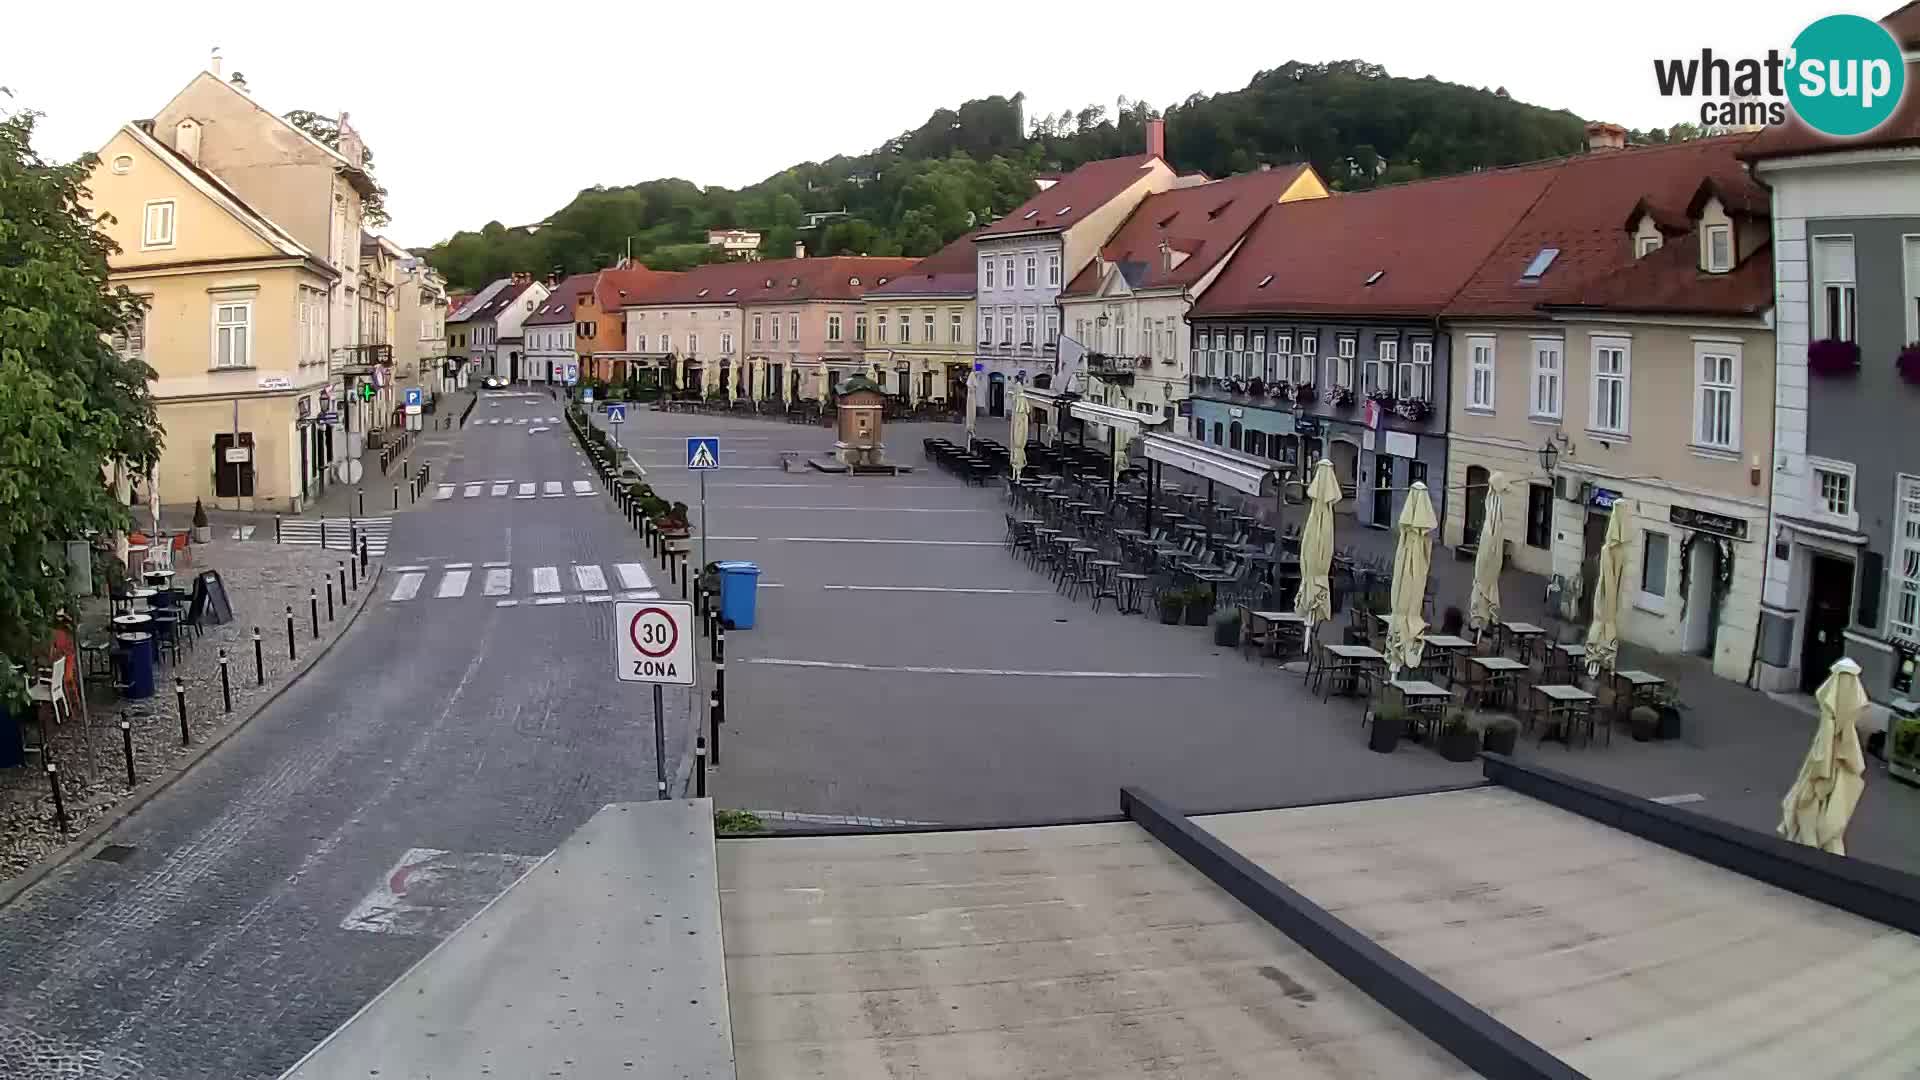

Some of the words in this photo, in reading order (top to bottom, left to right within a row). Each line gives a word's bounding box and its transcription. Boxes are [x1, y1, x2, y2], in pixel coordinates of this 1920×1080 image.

[409, 392, 417, 403] P
[643, 623, 666, 644] 30
[633, 660, 677, 677] ZONA
